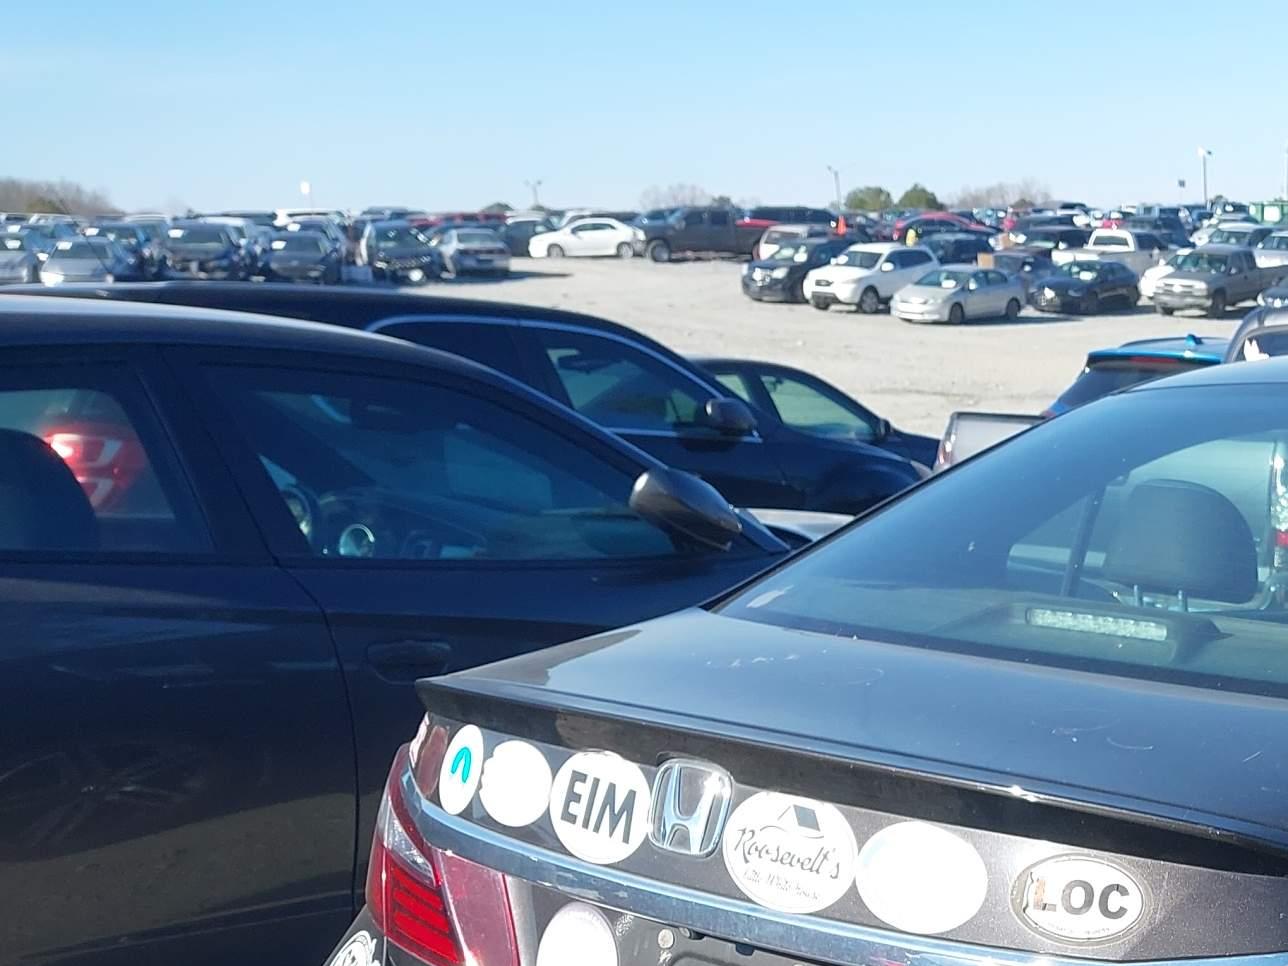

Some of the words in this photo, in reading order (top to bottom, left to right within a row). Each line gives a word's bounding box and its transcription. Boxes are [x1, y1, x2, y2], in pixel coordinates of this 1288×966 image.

[560, 769, 637, 844] EIM
[734, 827, 840, 880] Roosevelt's
[1033, 878, 1130, 920] LOC
